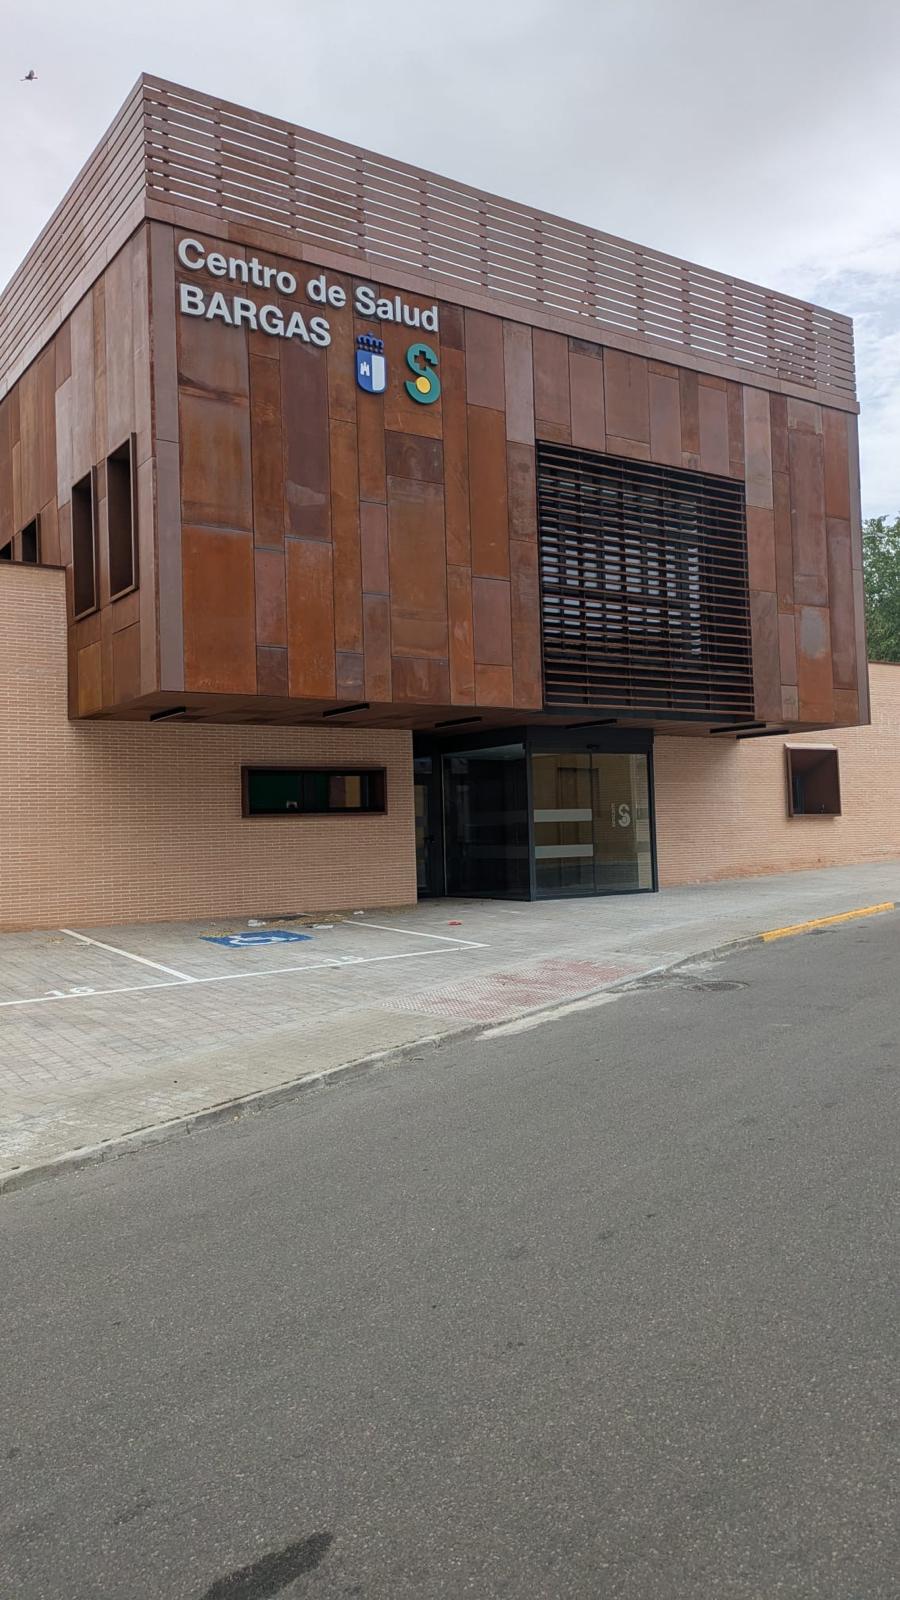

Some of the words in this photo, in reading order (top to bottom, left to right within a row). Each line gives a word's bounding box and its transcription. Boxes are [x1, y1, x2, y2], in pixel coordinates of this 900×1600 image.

[178, 238, 296, 295] Centro
[307, 275, 346, 308] de
[355, 285, 439, 332] Salud
[179, 283, 331, 347] BARGAS
